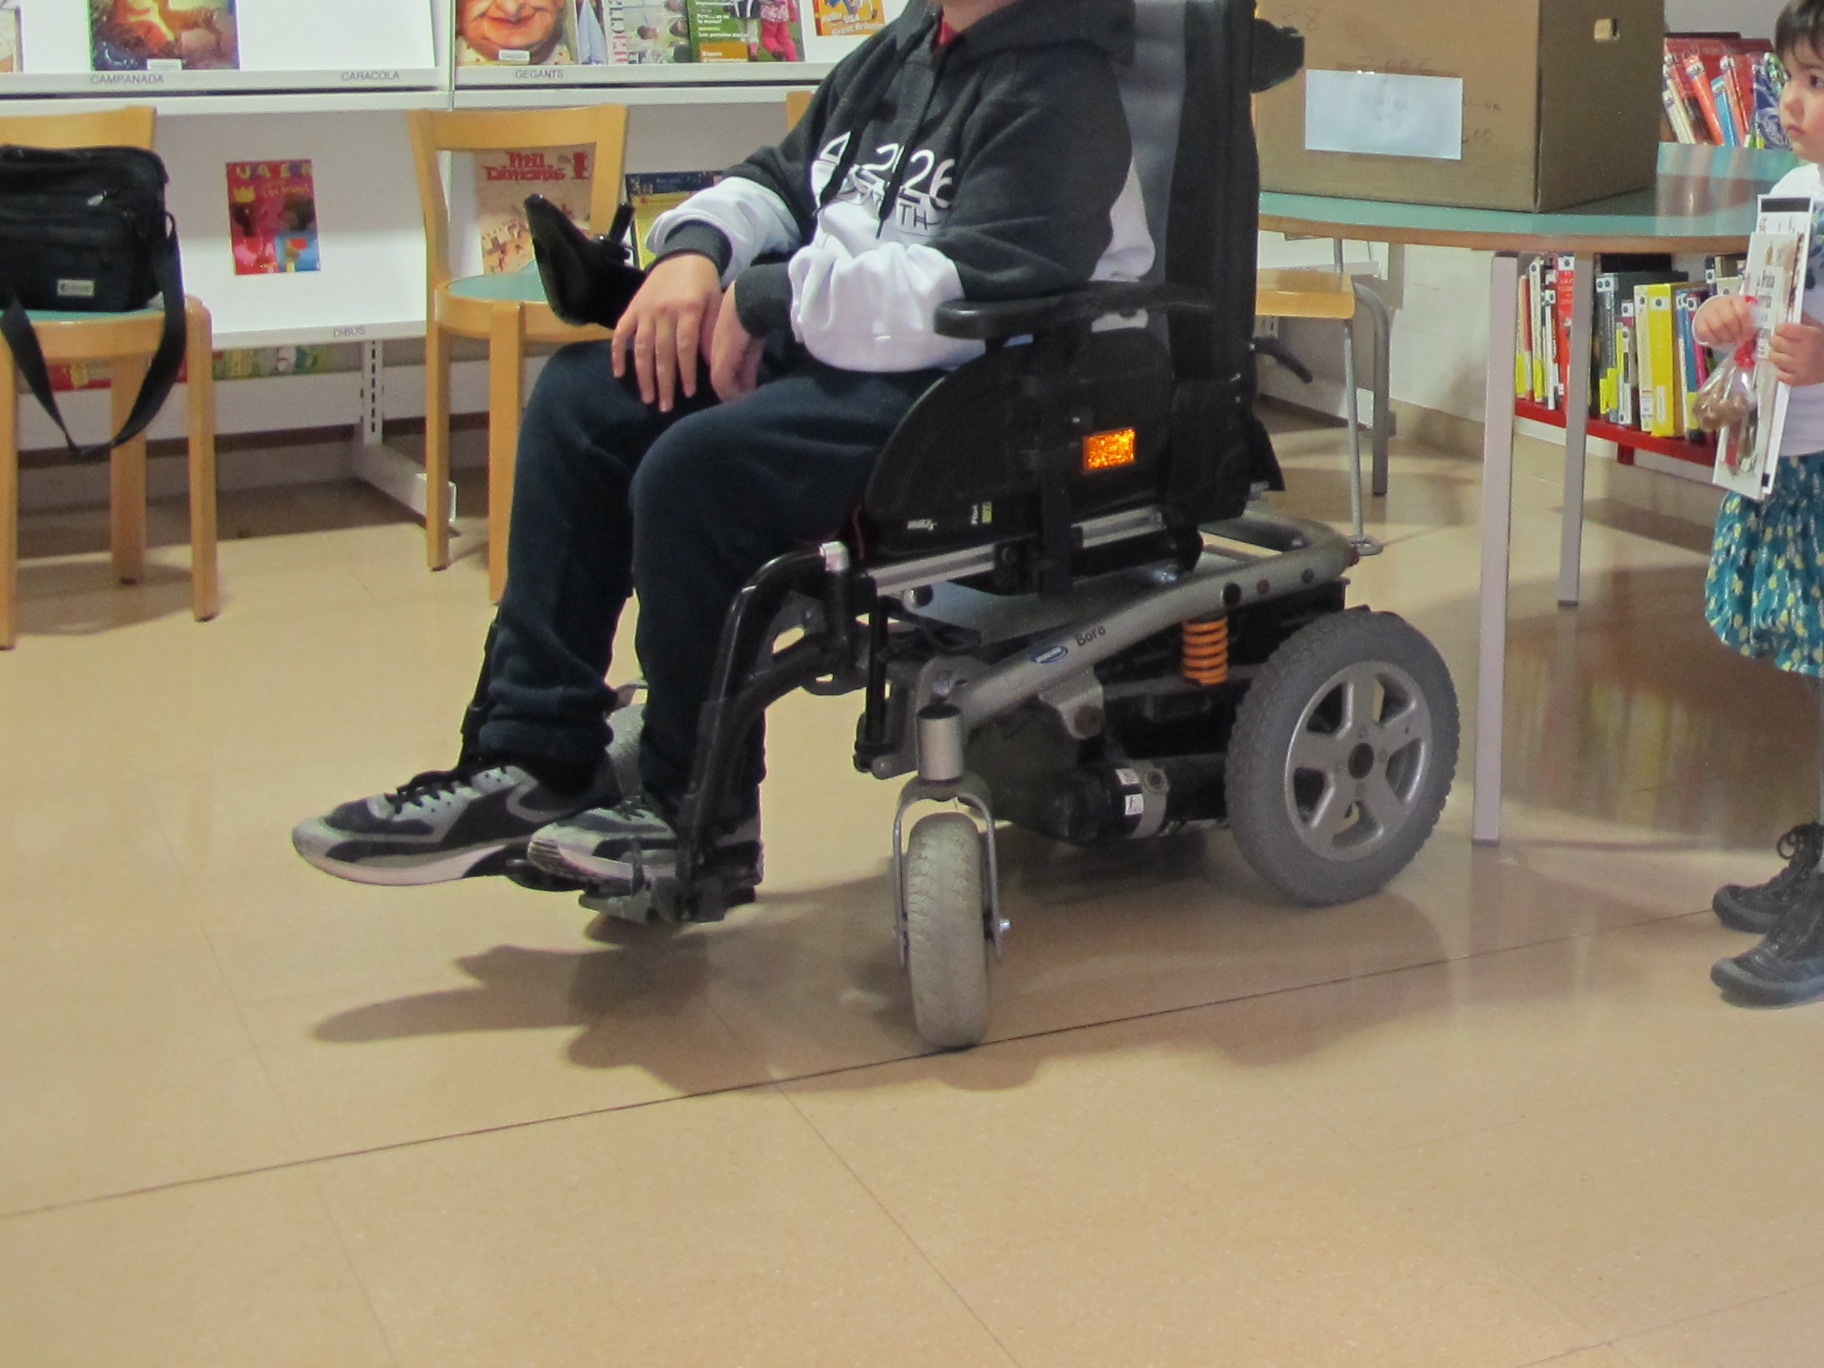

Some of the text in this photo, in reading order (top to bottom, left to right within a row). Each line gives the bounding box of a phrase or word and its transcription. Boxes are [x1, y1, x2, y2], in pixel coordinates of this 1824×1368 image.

[91, 74, 164, 85] CAMPANADA
[341, 70, 400, 81] CARACOLA
[515, 69, 564, 79] GEGANTS
